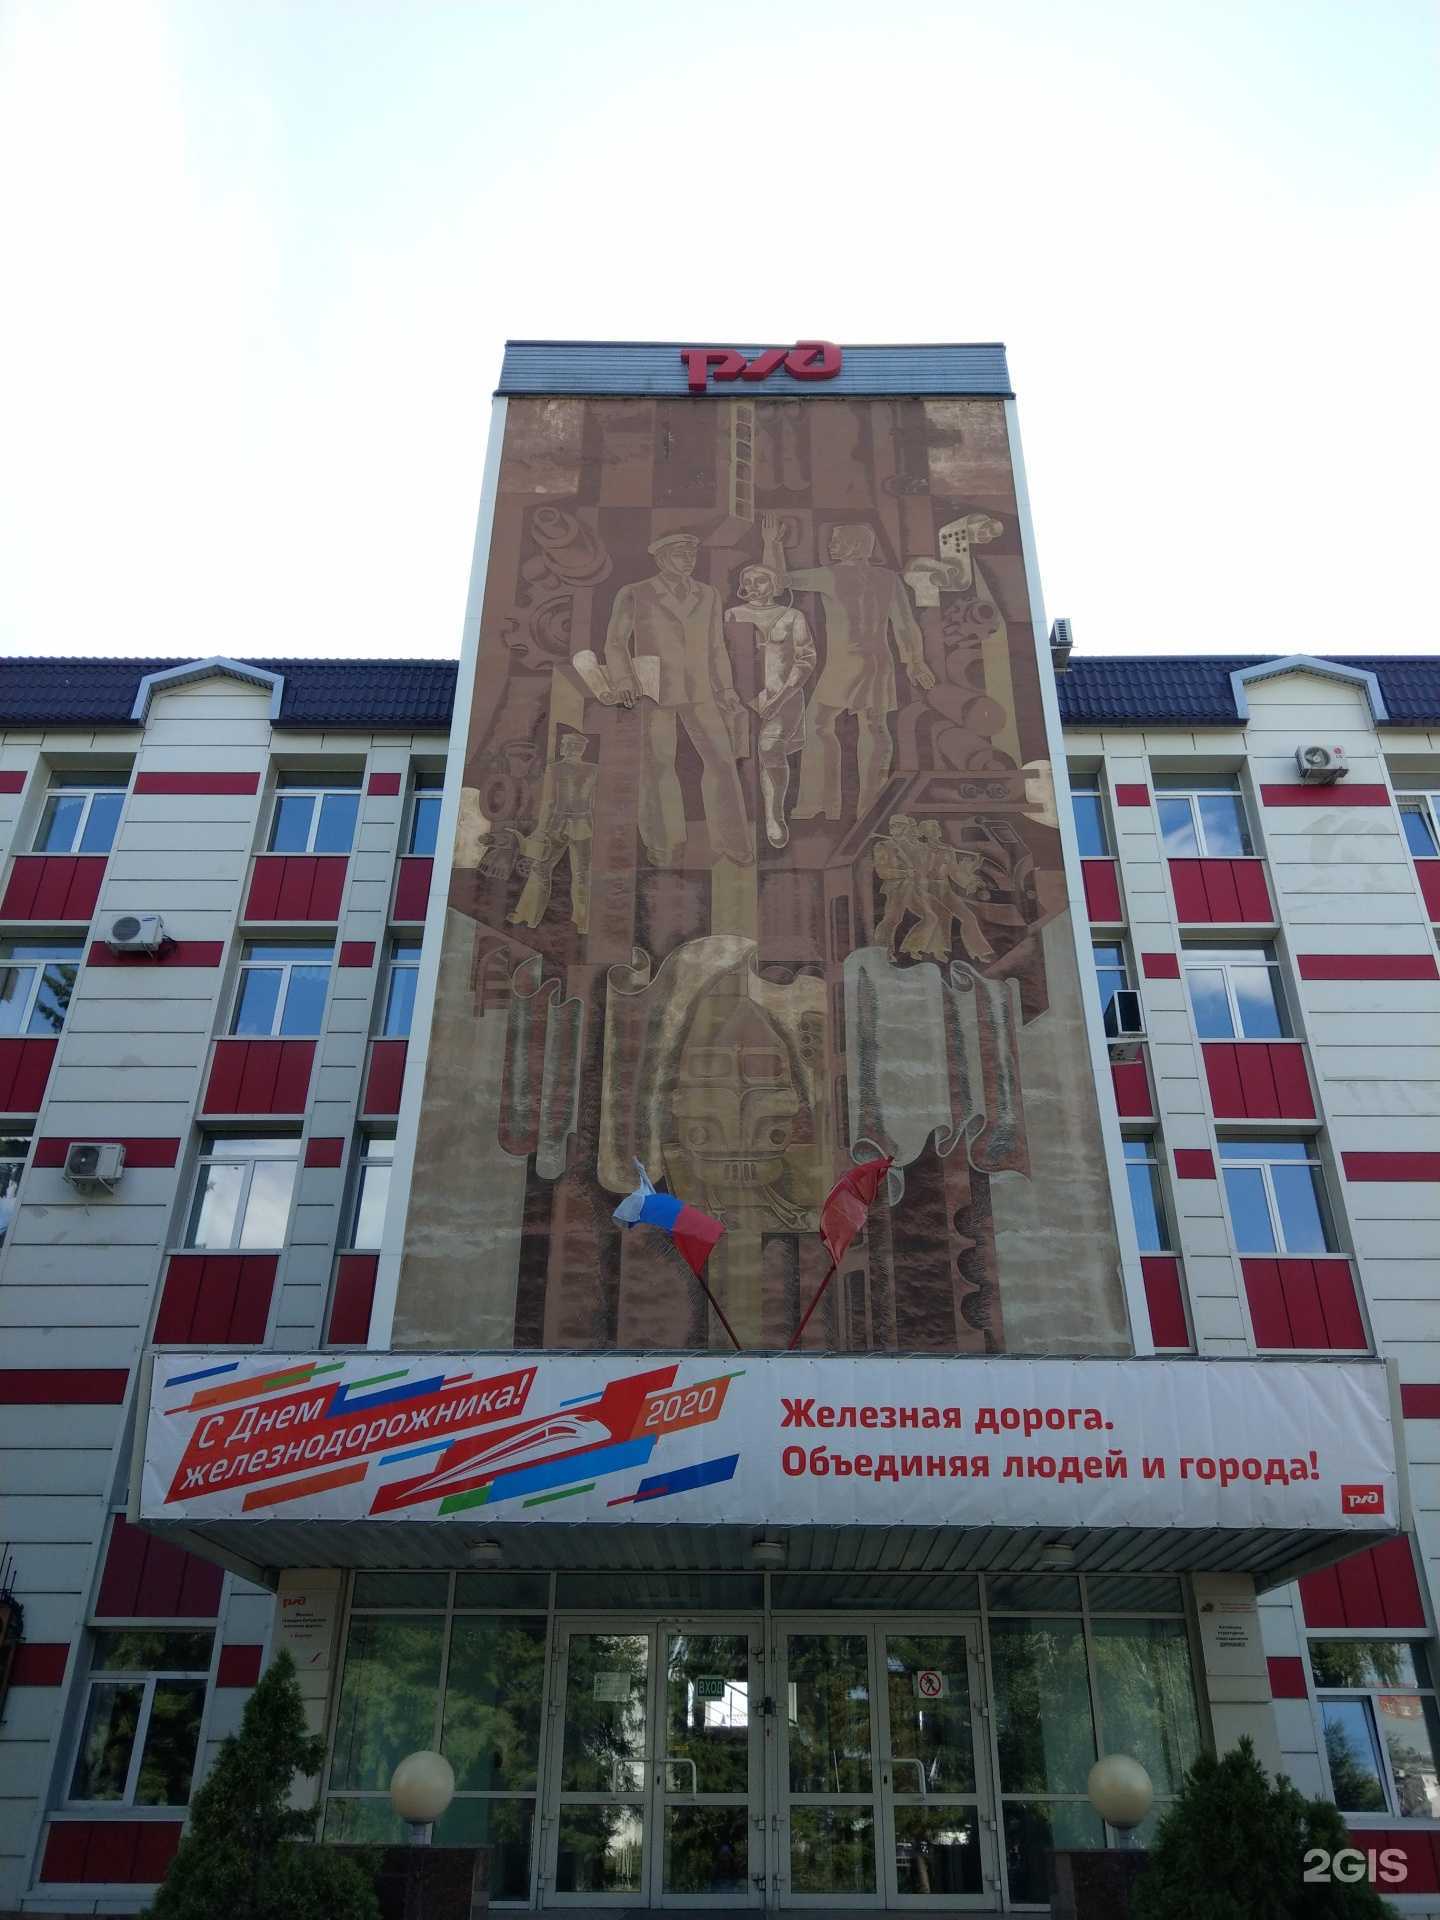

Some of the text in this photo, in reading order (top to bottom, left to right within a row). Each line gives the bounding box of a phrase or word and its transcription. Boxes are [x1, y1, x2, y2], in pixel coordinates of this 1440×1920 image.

[198, 1397, 326, 1449] С Днем
[644, 1386, 717, 1427] 2020
[780, 1398, 1114, 1438] Железная дорога.
[179, 1373, 530, 1491] железнодорожника!
[782, 1446, 1320, 1488] Объединяя людей и города!
[699, 1679, 724, 1697] ВХОД
